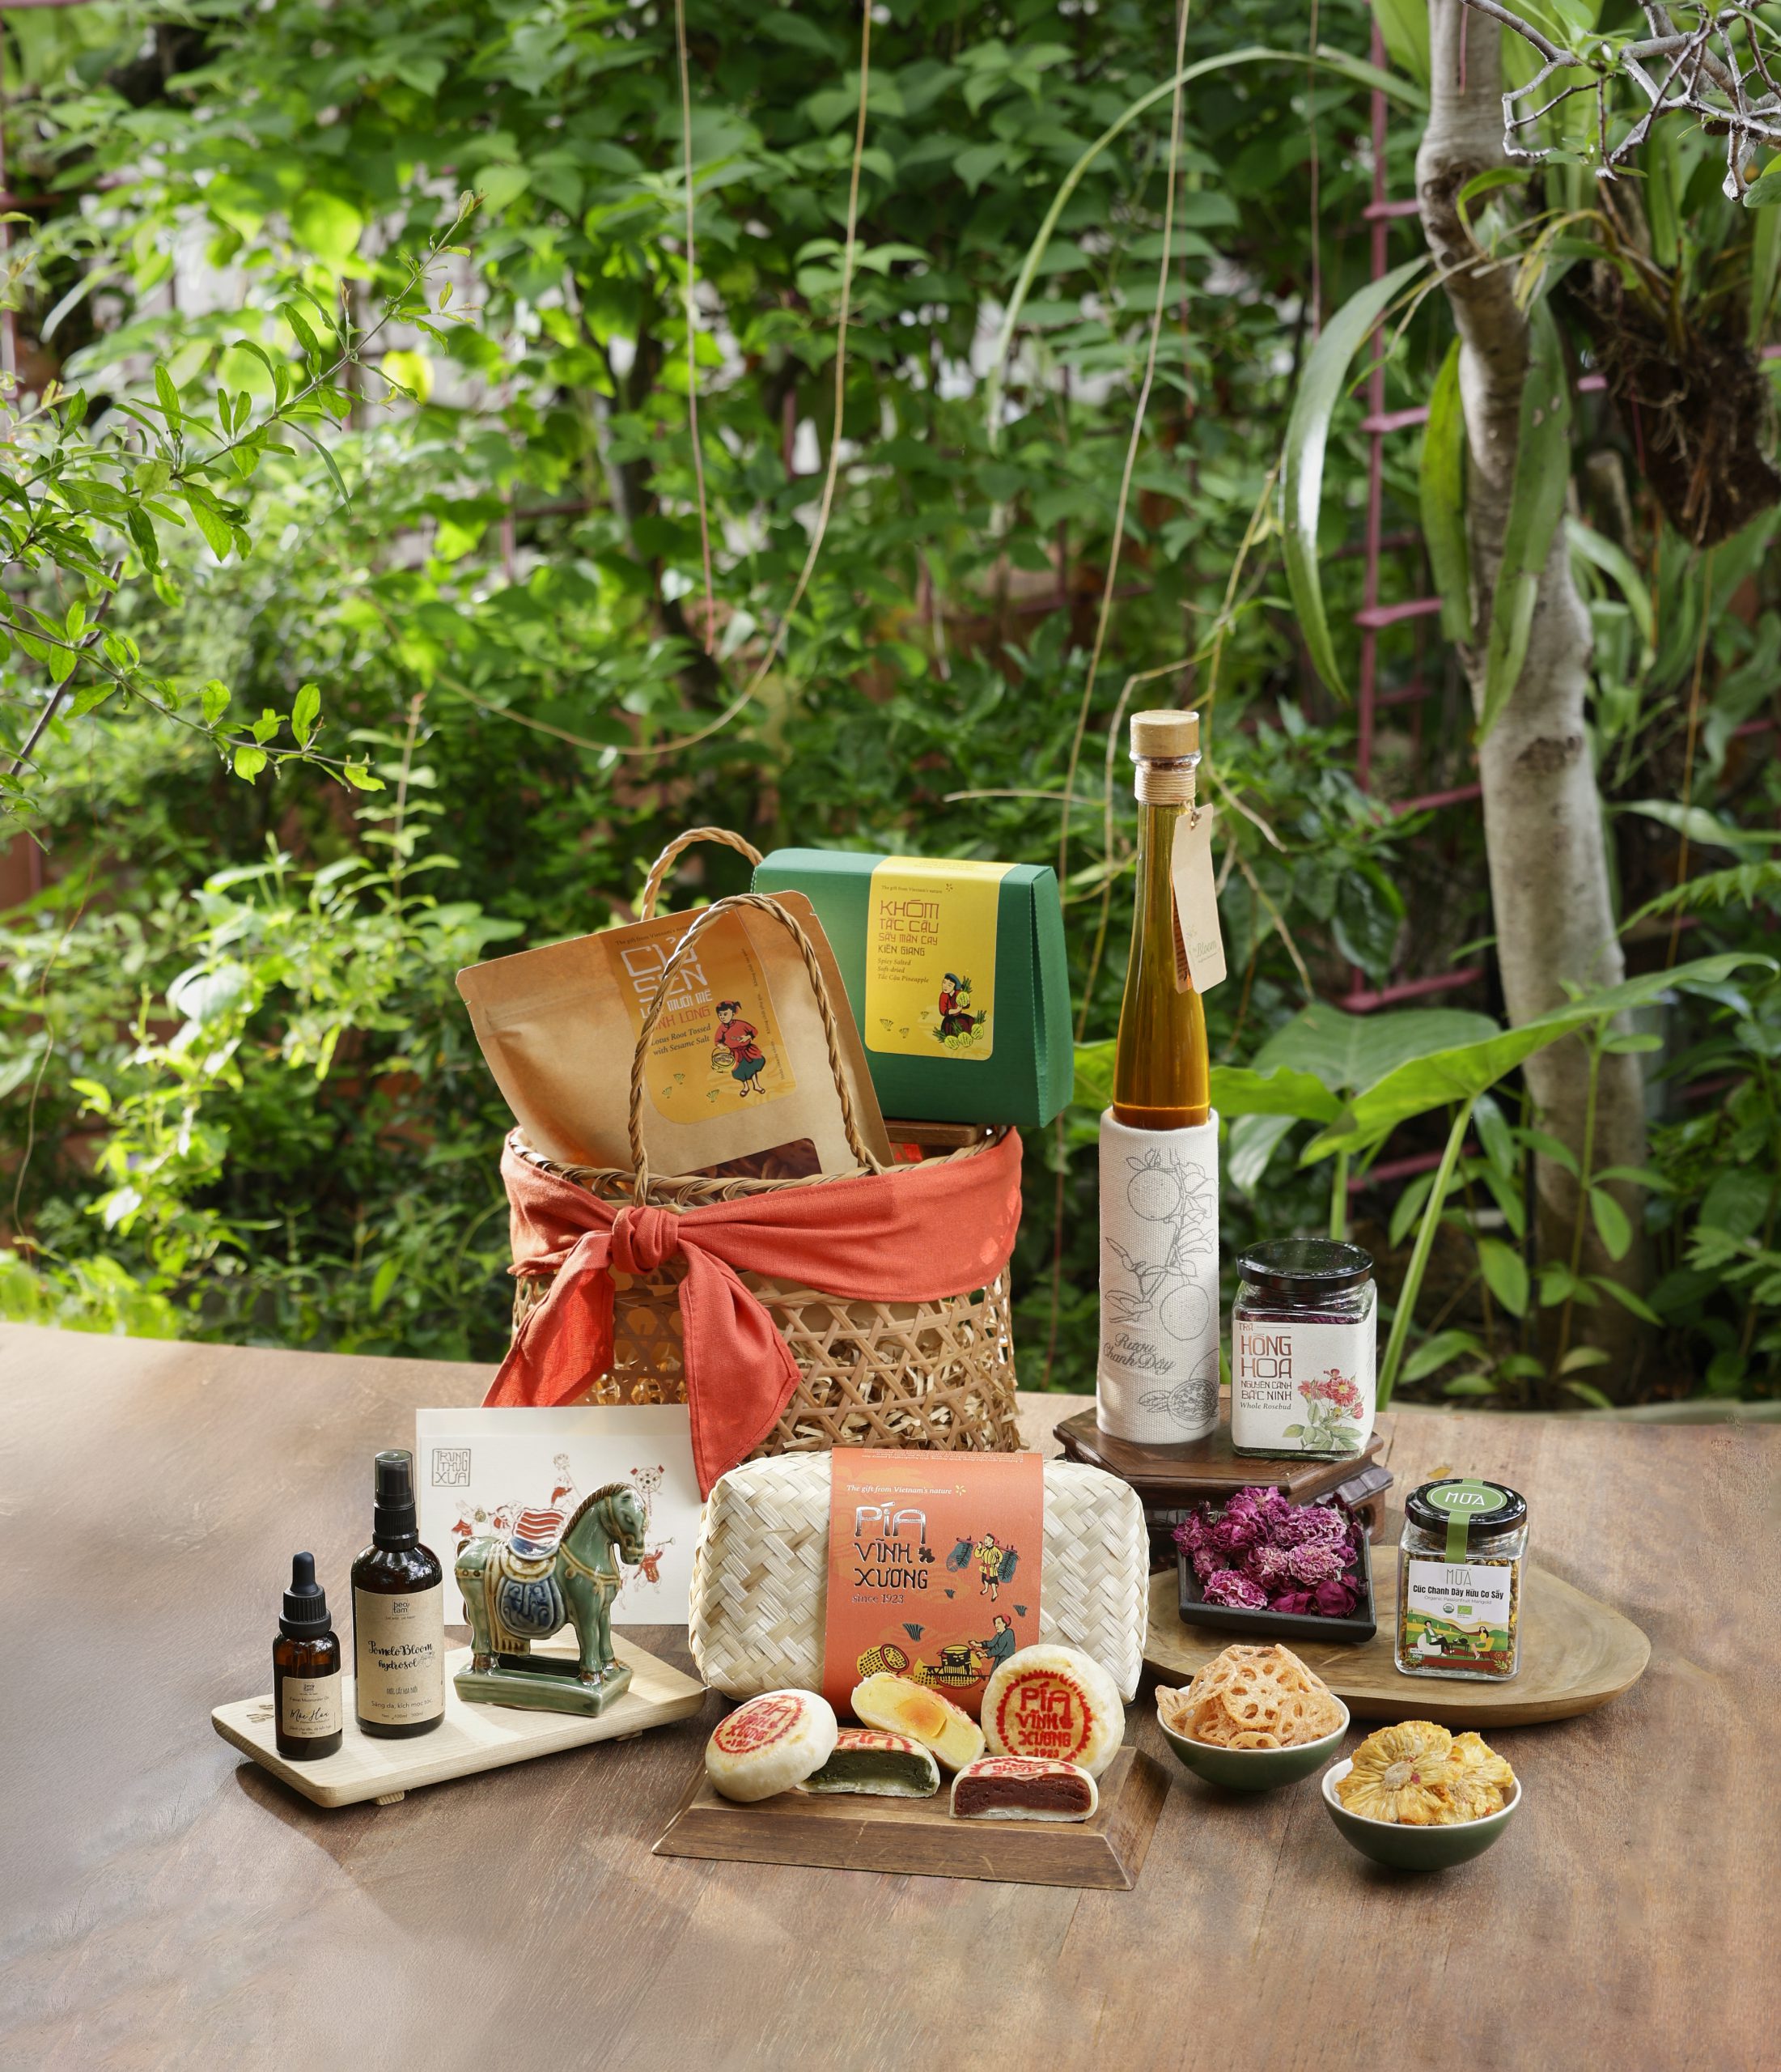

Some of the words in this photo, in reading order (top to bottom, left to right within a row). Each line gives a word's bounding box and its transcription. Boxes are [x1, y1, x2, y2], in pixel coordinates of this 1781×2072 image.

[880, 899, 939, 919] KHÓM
[921, 936, 938, 946] CAY
[901, 975, 929, 984] Pineapple
[679, 1005, 711, 1024] LONG
[671, 1032, 687, 1042] Root
[688, 1023, 711, 1036] Tossed
[669, 1040, 694, 1051] Sesame
[695, 1034, 710, 1045] Salt
[1240, 1332, 1292, 1357] HỒNG
[1240, 1357, 1292, 1379] HOA
[1266, 1391, 1292, 1401] NINH
[435, 1471, 467, 1485] XƯA
[846, 1484, 860, 1492] The
[861, 1485, 874, 1494] gift
[874, 1485, 892, 1494] from
[893, 1486, 928, 1495] Vietnam's
[853, 1538, 913, 1564] VĨNH
[853, 1567, 928, 1590] XƯƠNG
[852, 1592, 879, 1603] since
[881, 1593, 905, 1604] 1923
[1427, 1586, 1450, 1596] Chanh
[368, 1640, 400, 1656] Pomelo
[400, 1643, 434, 1657] Bloom
[378, 1658, 418, 1672] hydrosol
